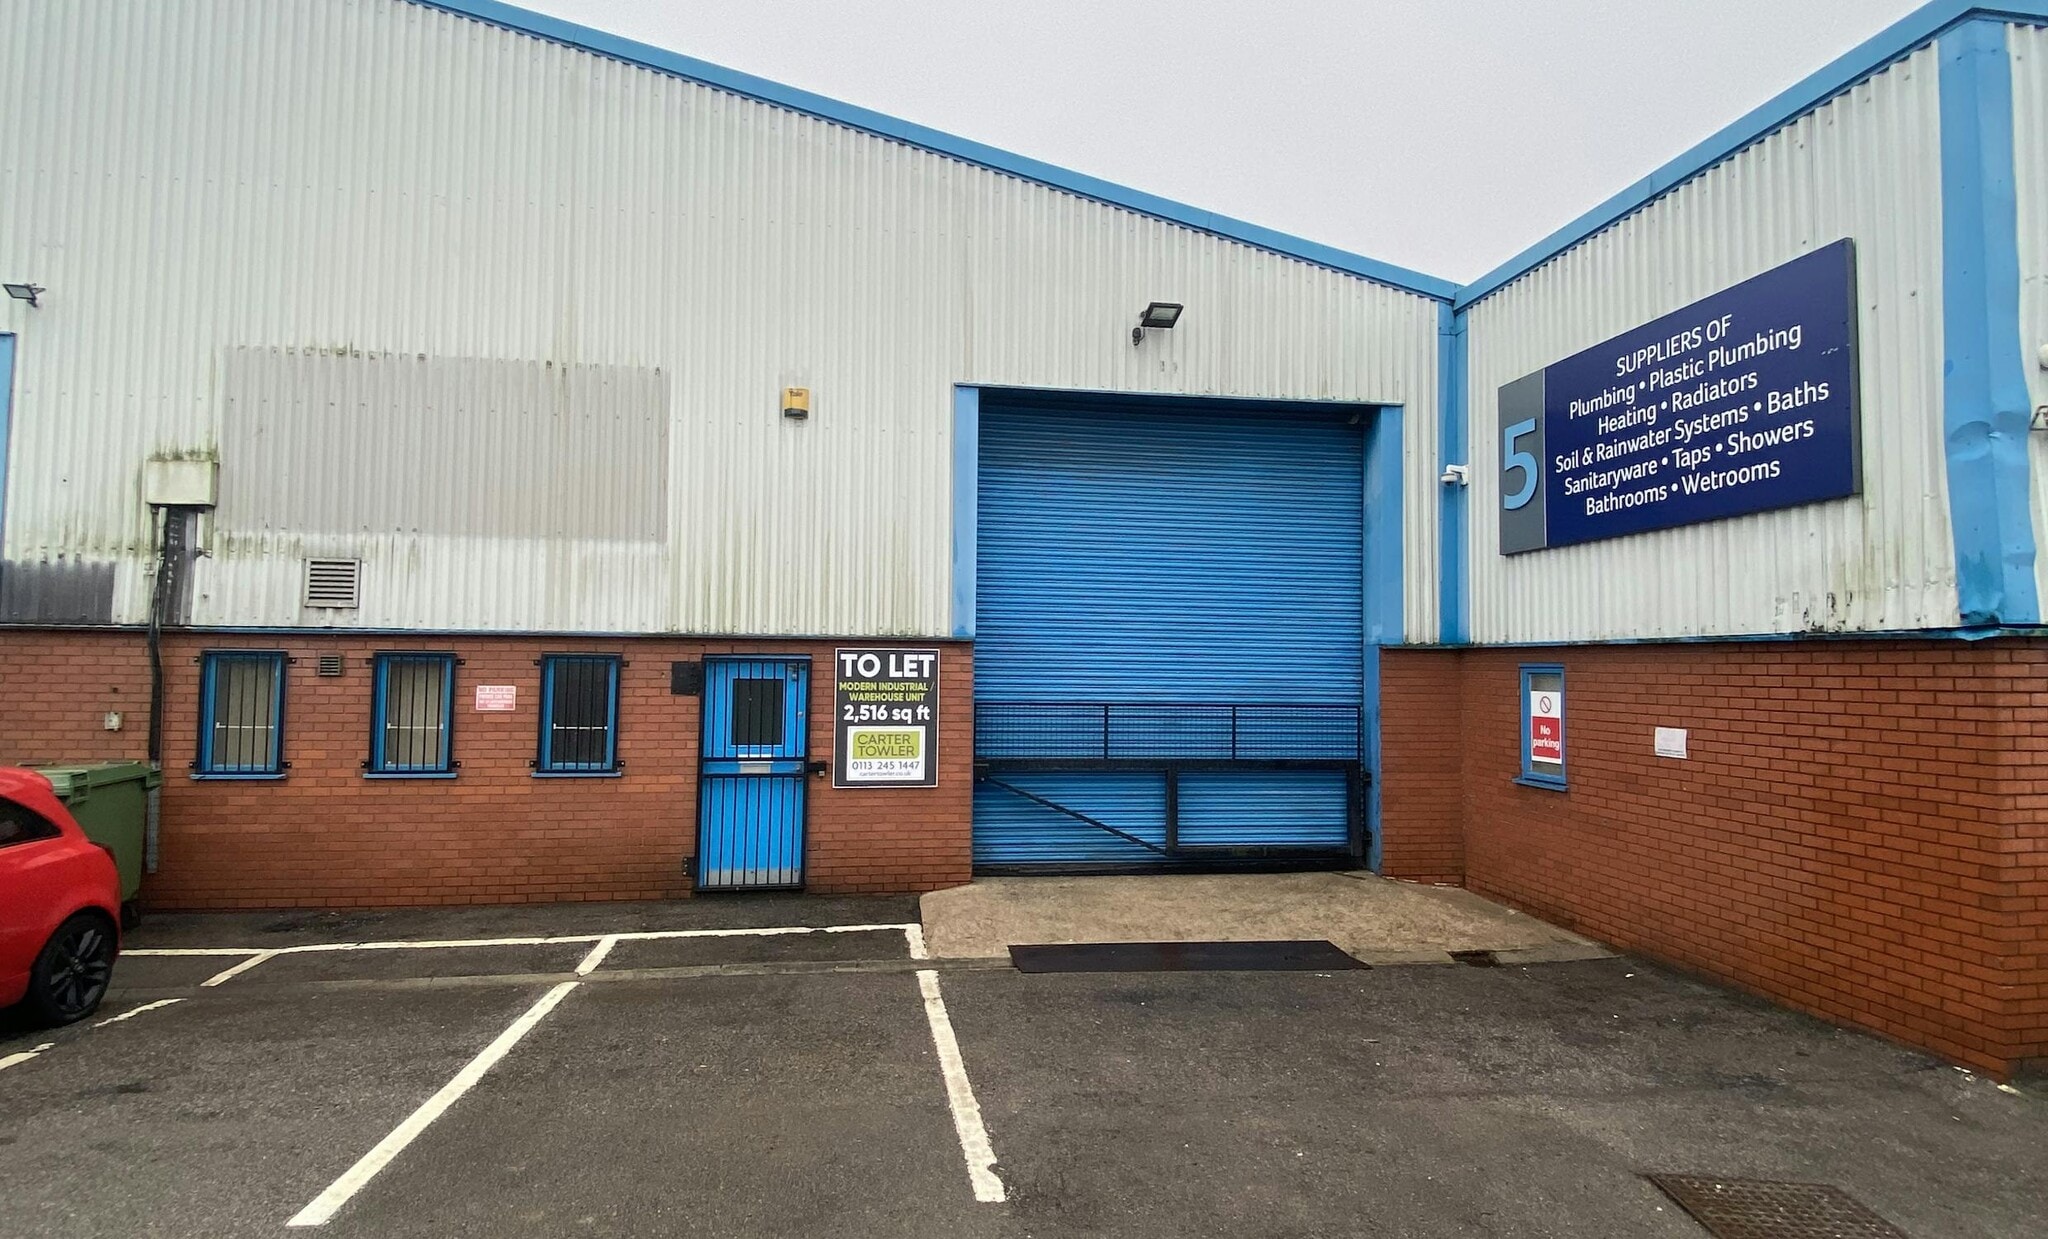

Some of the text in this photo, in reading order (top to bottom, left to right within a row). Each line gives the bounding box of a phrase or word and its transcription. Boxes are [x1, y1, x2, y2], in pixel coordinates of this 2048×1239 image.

[1616, 314, 1732, 377] SUPPLIERS OF
[1569, 323, 1802, 420] Plumbing Plastic Plumbing
[1598, 370, 1758, 436] Heating Radiators
[1555, 380, 1829, 474] Soil & Rainwater Systems Baths
[1503, 417, 1538, 511] 5
[1564, 418, 1814, 496] Sanitaryware Taps Showers
[1586, 458, 1781, 516] Bathrooms Wetrooms
[840, 653, 935, 678] TO LET
[839, 682, 877, 691] MODERN
[879, 682, 928, 691] INDUSTRIAL
[849, 693, 925, 702] WAREHOUSE UNIT
[843, 704, 930, 724] 2,516 sq ft
[857, 734, 911, 744] CARTER
[1540, 724, 1551, 735] No
[858, 745, 915, 757] TOWLER
[1533, 738, 1560, 751] parking
[852, 761, 919, 770] 0113 245 1447
